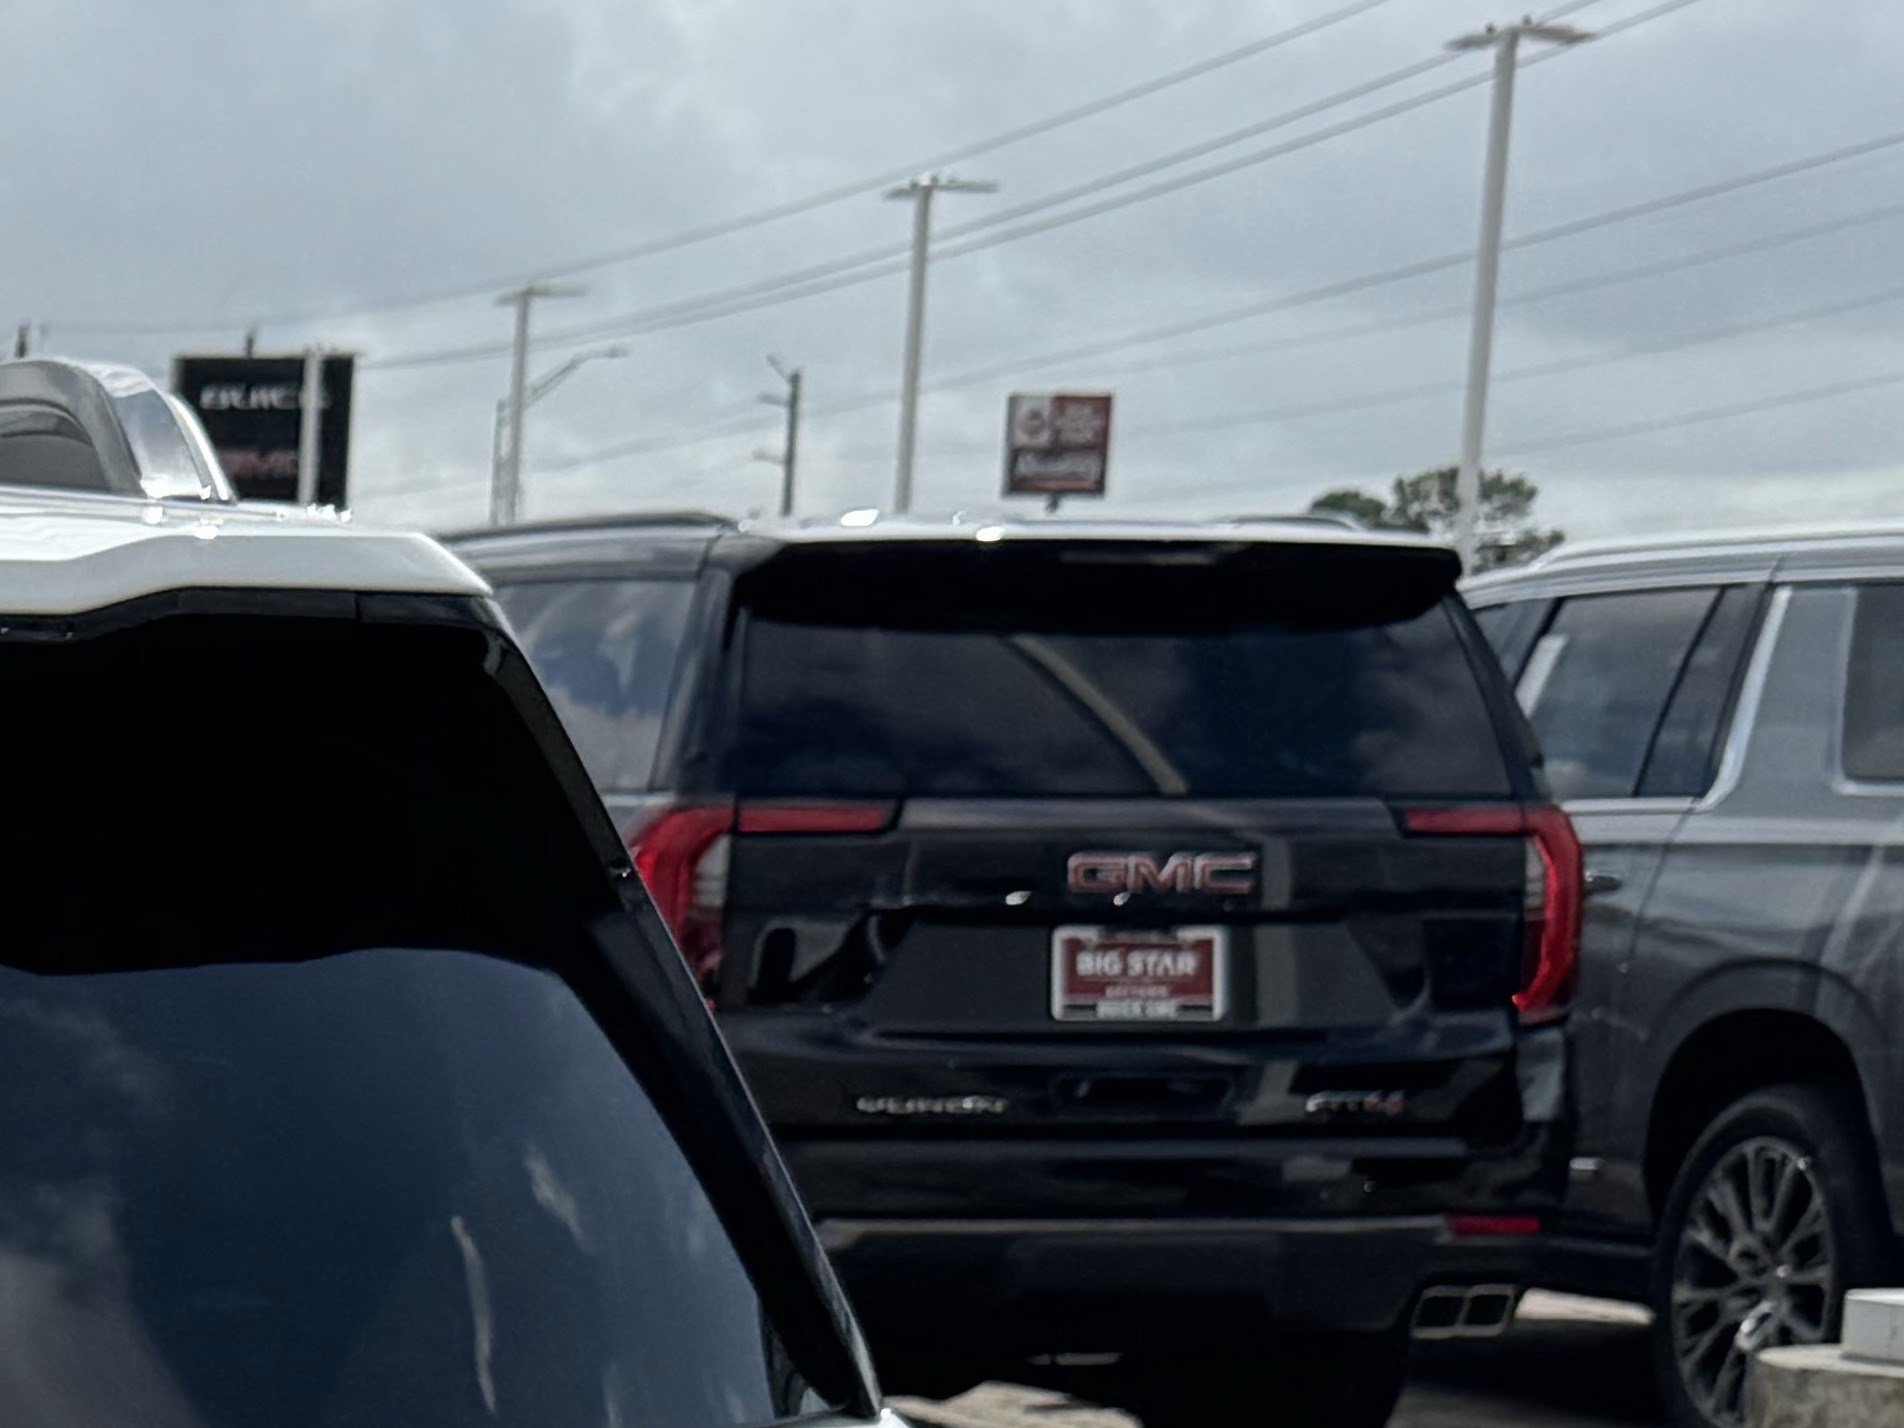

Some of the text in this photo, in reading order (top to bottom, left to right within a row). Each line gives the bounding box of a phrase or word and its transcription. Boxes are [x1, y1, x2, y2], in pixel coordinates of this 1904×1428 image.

[1067, 851, 1256, 894] GMC
[1075, 951, 1198, 977] BIG STAR
